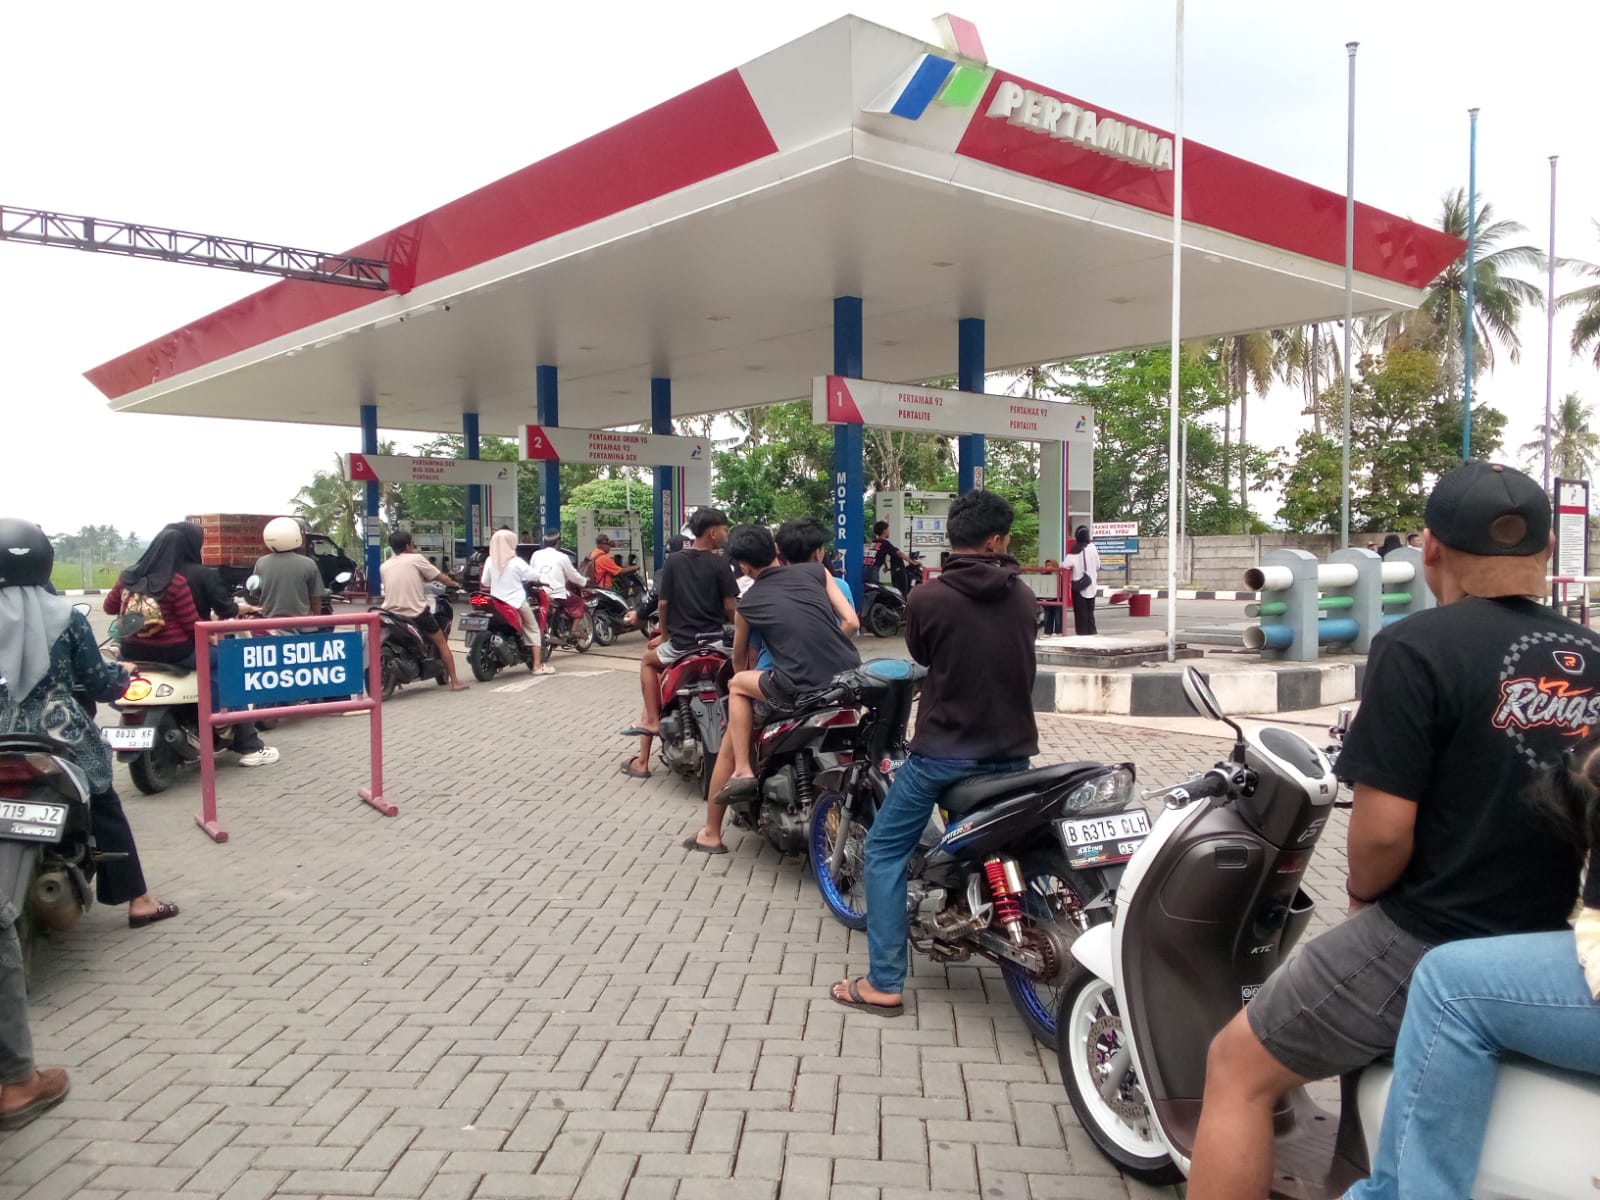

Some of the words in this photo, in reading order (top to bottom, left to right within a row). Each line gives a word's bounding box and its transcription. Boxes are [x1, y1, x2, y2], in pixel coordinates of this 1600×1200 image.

[985, 81, 1173, 171] PERTAMINA
[836, 391, 843, 407] 1
[898, 392, 933, 406] PERTAMAX
[934, 397, 943, 407] 92
[898, 409, 931, 421] PERTALITE
[1010, 405, 1039, 417] PERTAMAX
[1040, 408, 1048, 417] 92
[1010, 420, 1037, 431] PERTALITE
[533, 436, 542, 449] 2
[589, 433, 621, 442] PERTAMAX
[589, 442, 621, 451] PERTAMAX
[589, 451, 625, 460] PERTAMINA
[356, 462, 363, 472] 3
[412, 459, 444, 467] PERTAMINA
[837, 472, 847, 540] MOTOR
[243, 645, 277, 668] BIO
[283, 639, 346, 665] SOLAR
[244, 666, 346, 691] KOSONG
[40, 807, 60, 822] JZ
[1068, 825, 1078, 842] B
[1082, 820, 1116, 841] 6375
[1121, 816, 1148, 834] CLH
